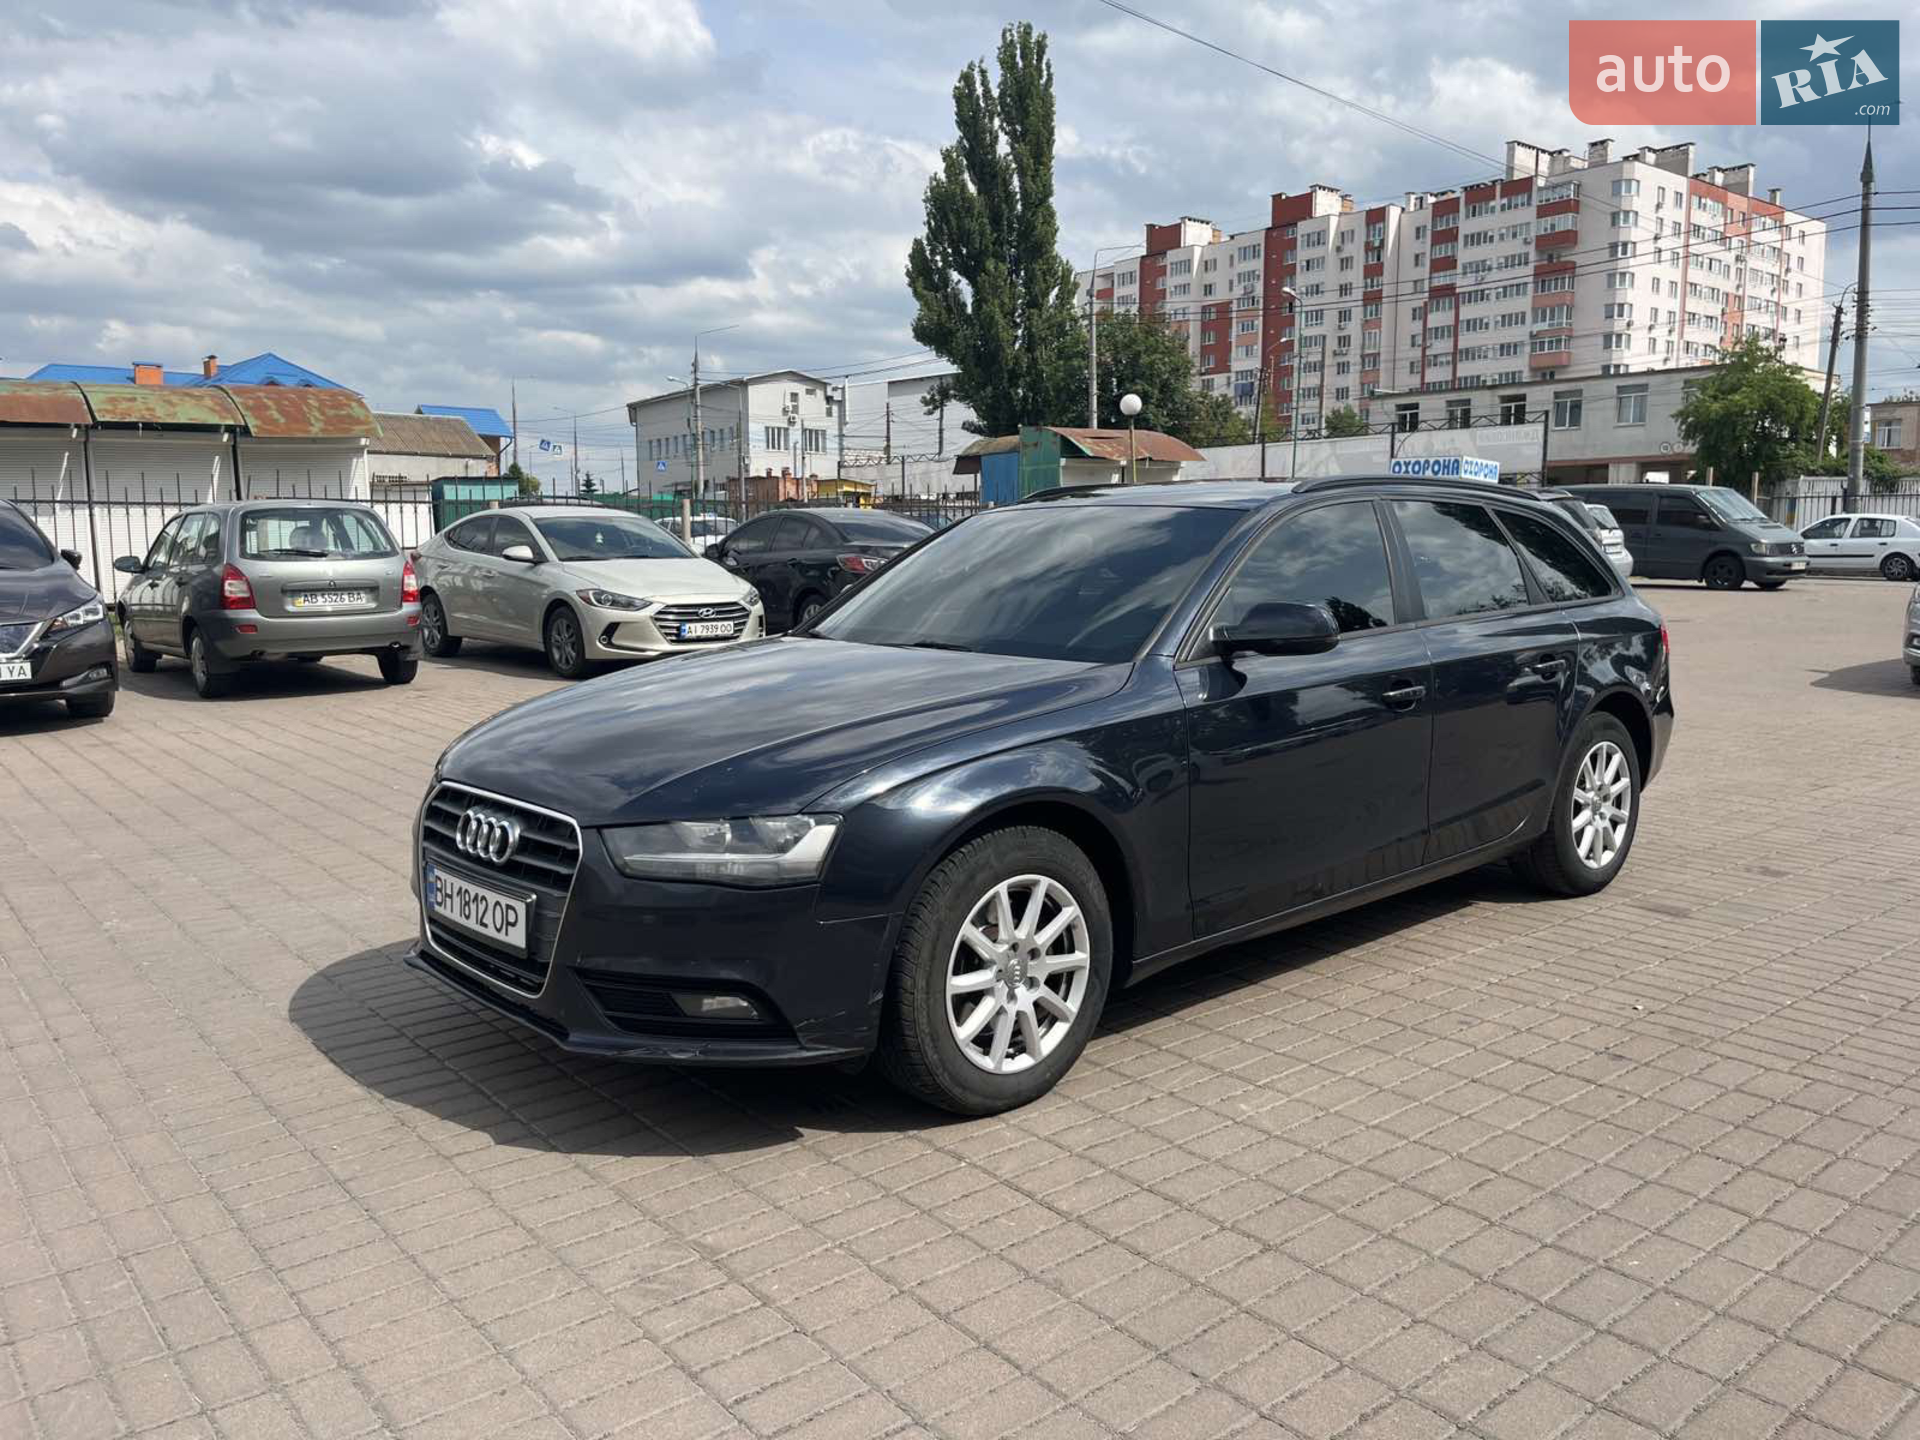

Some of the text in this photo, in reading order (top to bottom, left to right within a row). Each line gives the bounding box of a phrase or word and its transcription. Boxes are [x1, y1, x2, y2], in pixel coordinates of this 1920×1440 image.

[1392, 458, 1460, 476] ОХОРОНА
[1463, 458, 1498, 481] ОХОРОНА
[303, 592, 364, 604] AB 5526 BA
[700, 624, 719, 634] 7939
[435, 874, 519, 937] BH 1812 OP
